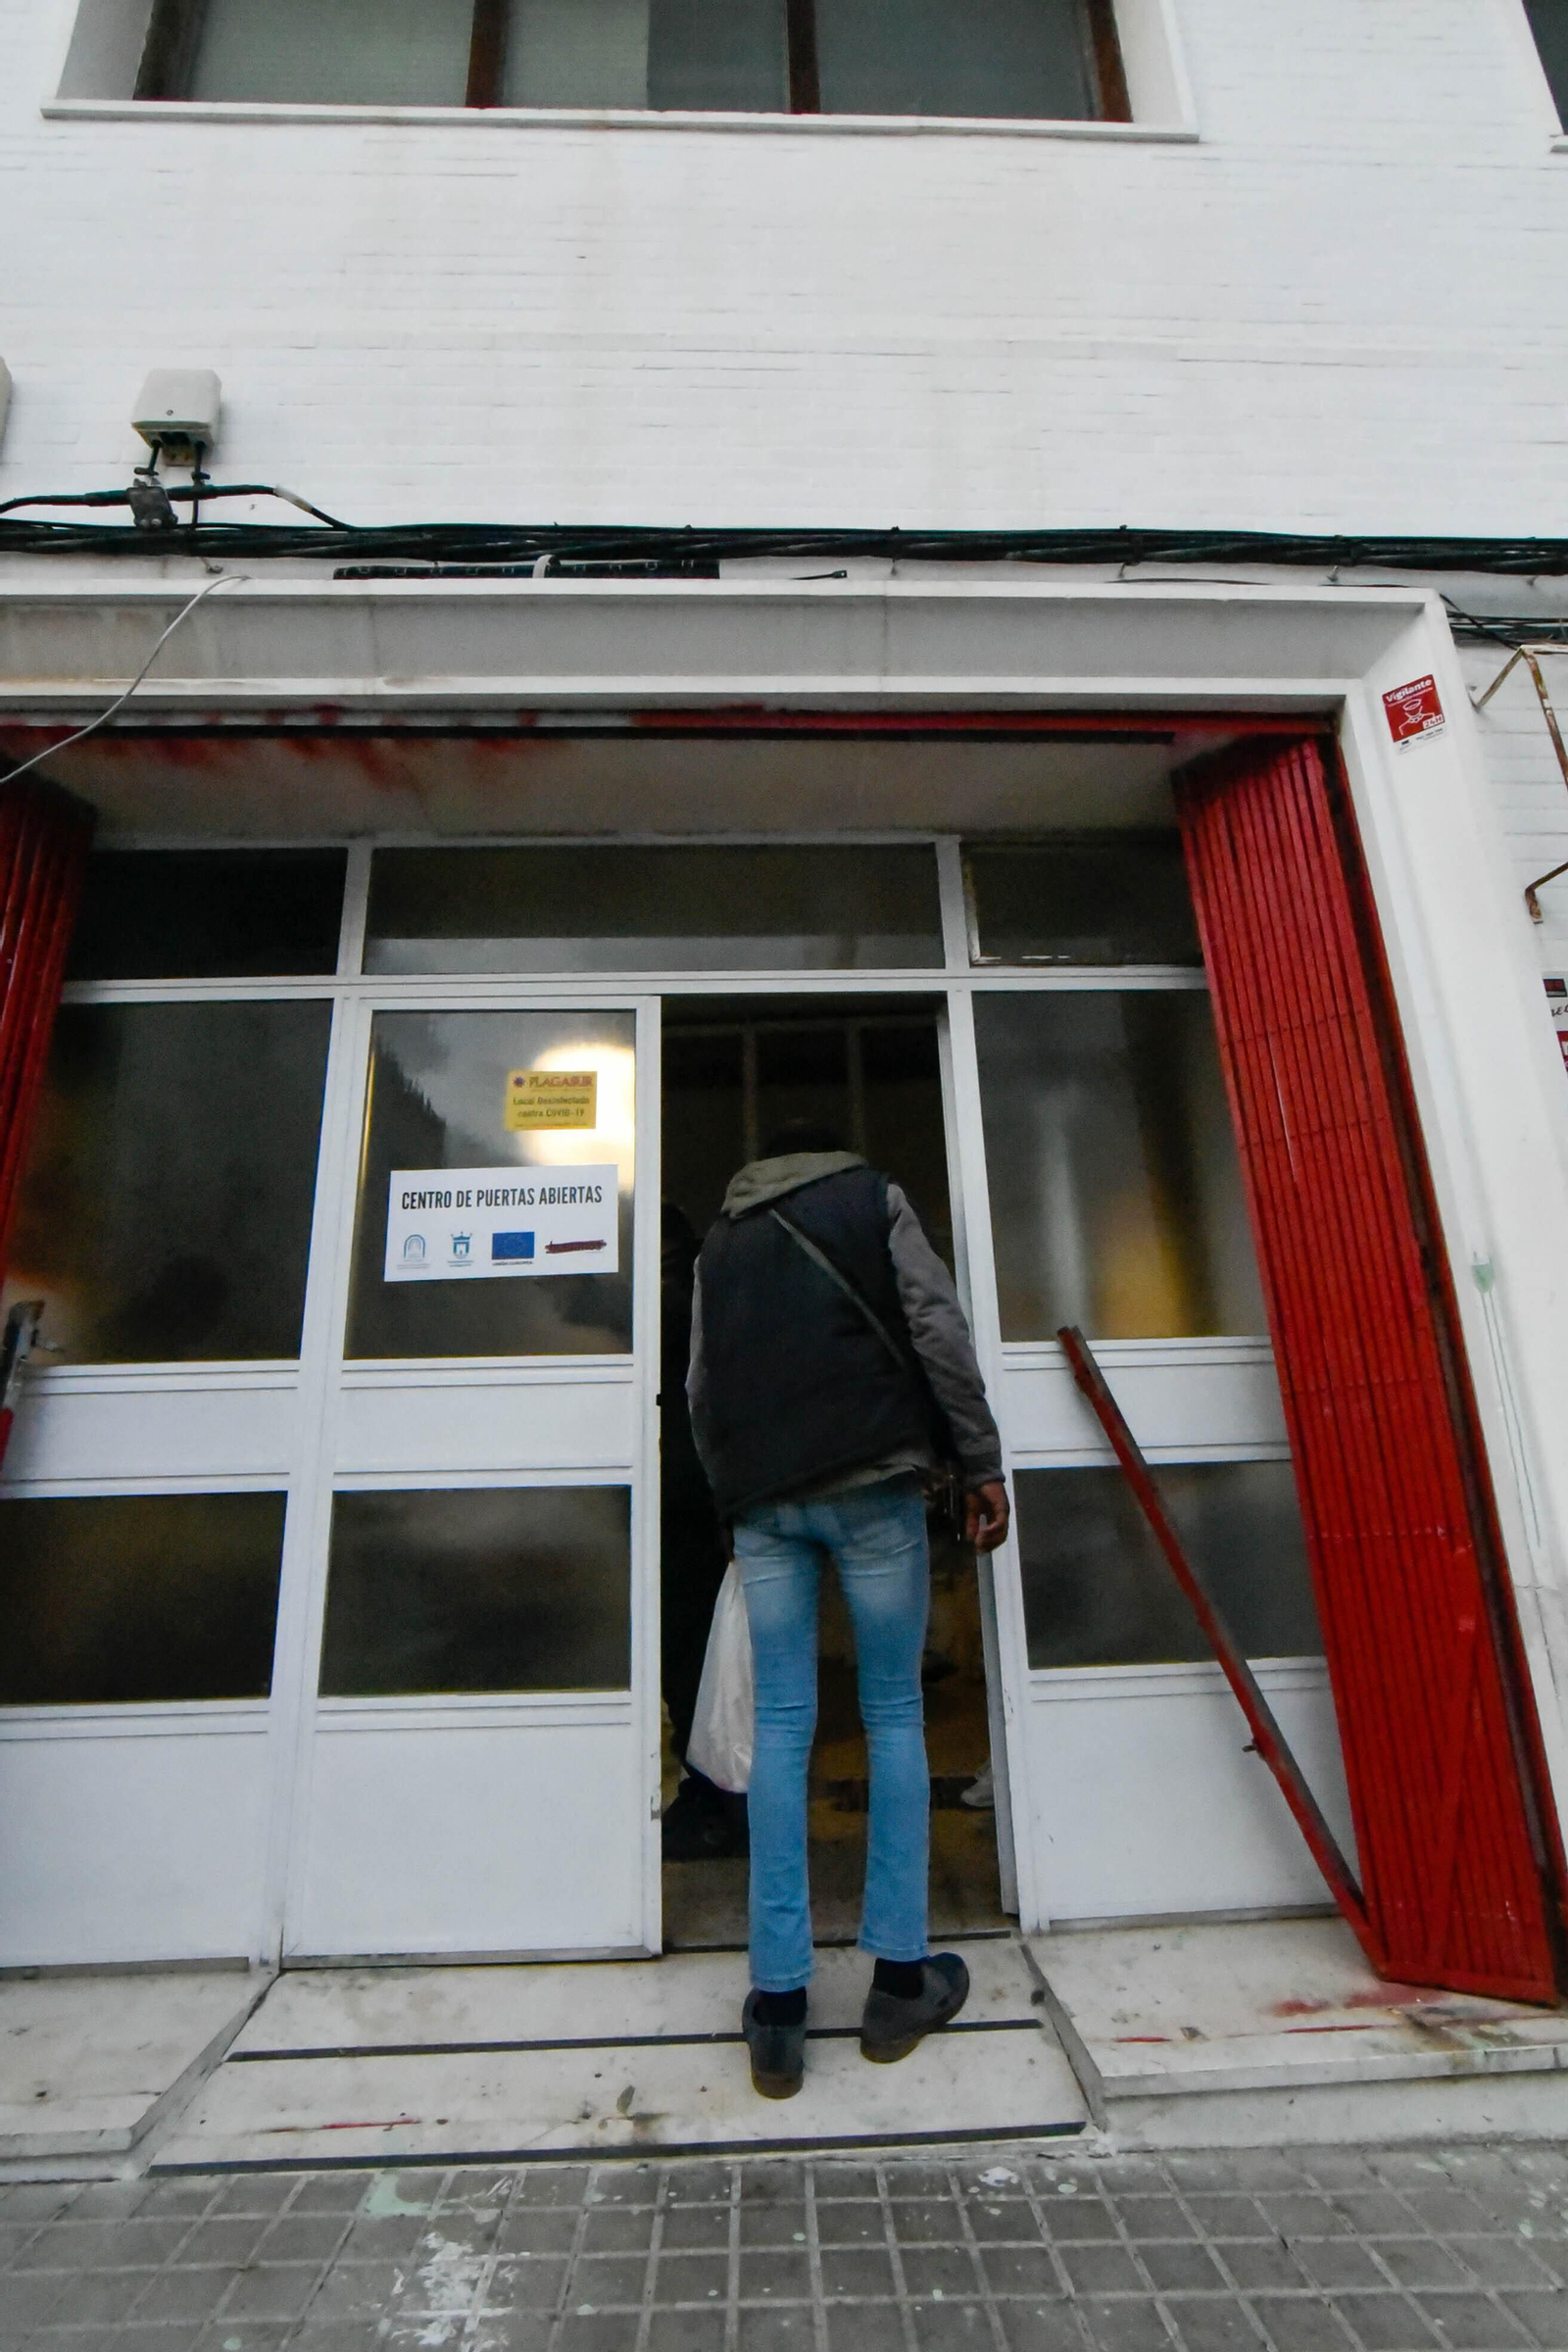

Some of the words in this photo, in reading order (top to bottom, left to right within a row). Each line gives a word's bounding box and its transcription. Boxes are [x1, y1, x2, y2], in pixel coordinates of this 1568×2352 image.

[1386, 679, 1433, 703] Vigilante
[402, 1191, 452, 1209] CENTRO
[456, 1190, 472, 1207] DE
[476, 1188, 535, 1206] PUERTAS
[539, 1186, 603, 1204] ABIERTAS
